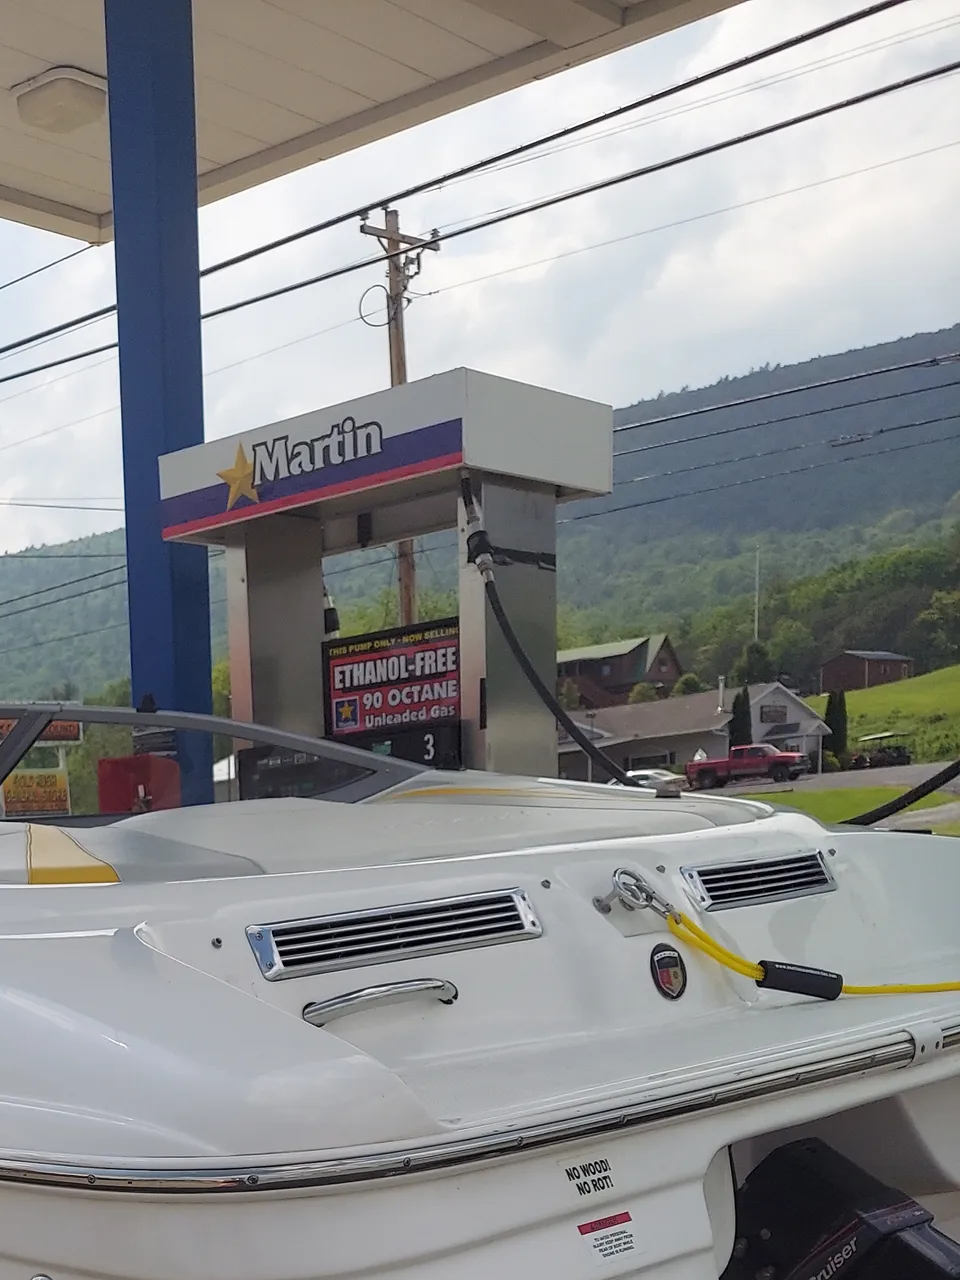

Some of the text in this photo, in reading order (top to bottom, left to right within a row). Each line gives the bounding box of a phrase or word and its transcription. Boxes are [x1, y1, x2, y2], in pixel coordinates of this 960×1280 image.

[252, 416, 383, 488] Martin
[349, 642, 373, 653] PUMP
[374, 638, 395, 648] ONLY
[402, 632, 424, 643] NOW
[334, 647, 457, 690] ETHANOL-FREE
[362, 680, 458, 710] 90 OCTANE
[365, 706, 427, 728] Unleaded
[430, 704, 455, 719] Gas
[423, 733, 435, 760] 3
[565, 1158, 612, 1182] NO WOOD!
[576, 1175, 614, 1196] NO ROT!
